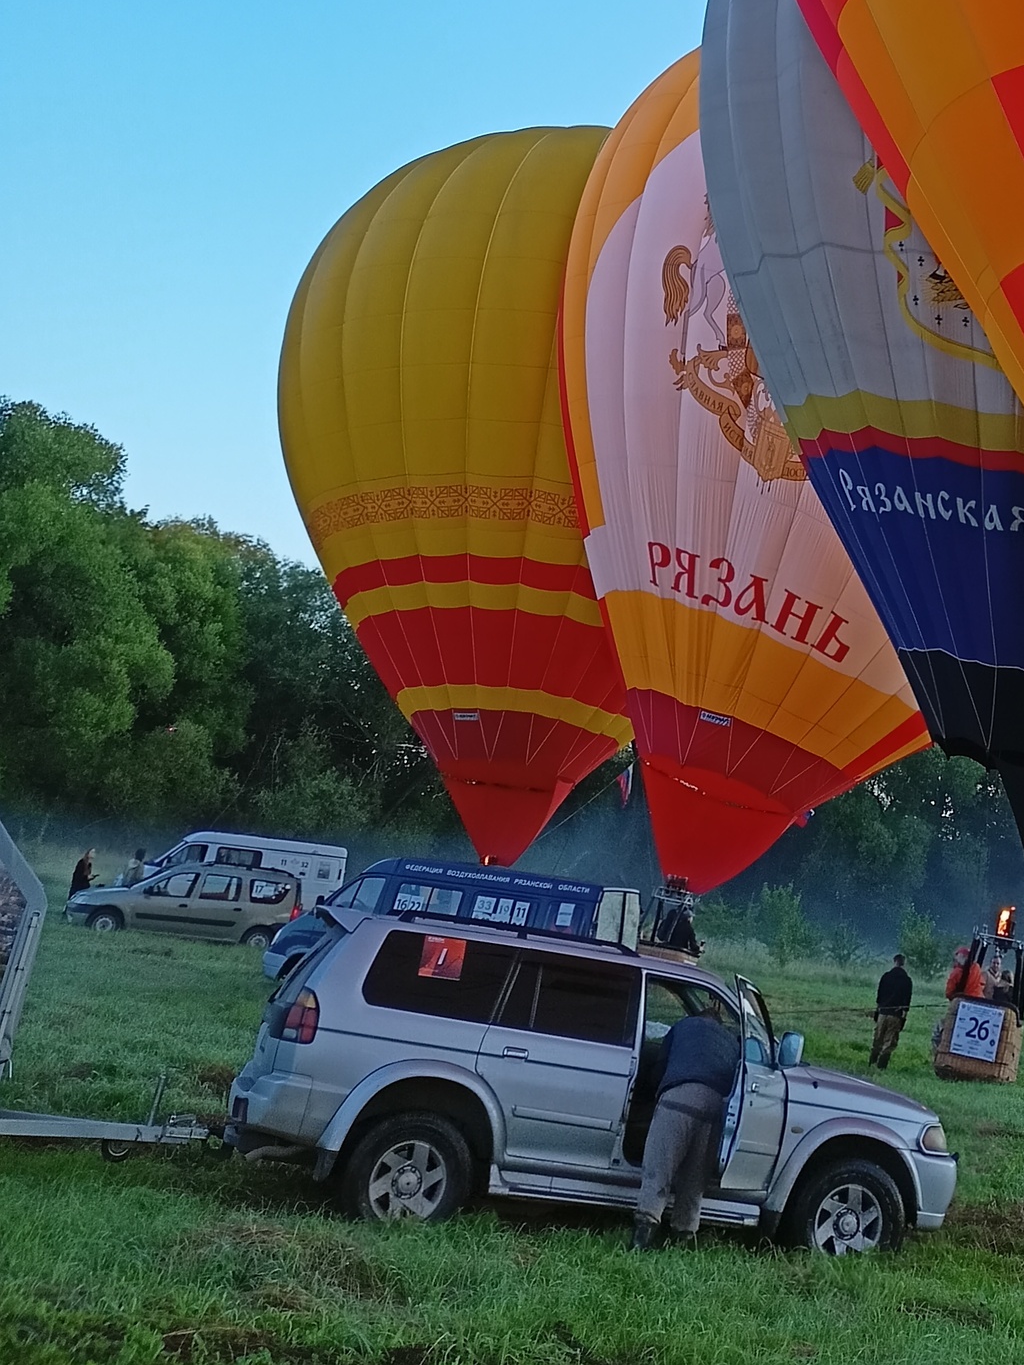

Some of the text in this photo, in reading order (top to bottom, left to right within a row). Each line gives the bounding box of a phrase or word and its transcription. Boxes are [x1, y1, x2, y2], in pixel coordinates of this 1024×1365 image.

[688, 372, 725, 412] СЛАВНАЯ
[723, 422, 754, 460] ИСТОИЯ
[647, 541, 850, 663] РЯЗАНЬ
[405, 864, 591, 894] ФЕДЕРАЦИЯ ВОЗДУХОПЛАВАНИЯ РЯЗАНСКОЙ ОБЛАСТИ
[255, 884, 264, 893] 17
[397, 899, 408, 910] 16
[410, 901, 422, 911] 22
[477, 900, 492, 911] 33
[516, 907, 527, 918] 11
[965, 1016, 990, 1041] 26
